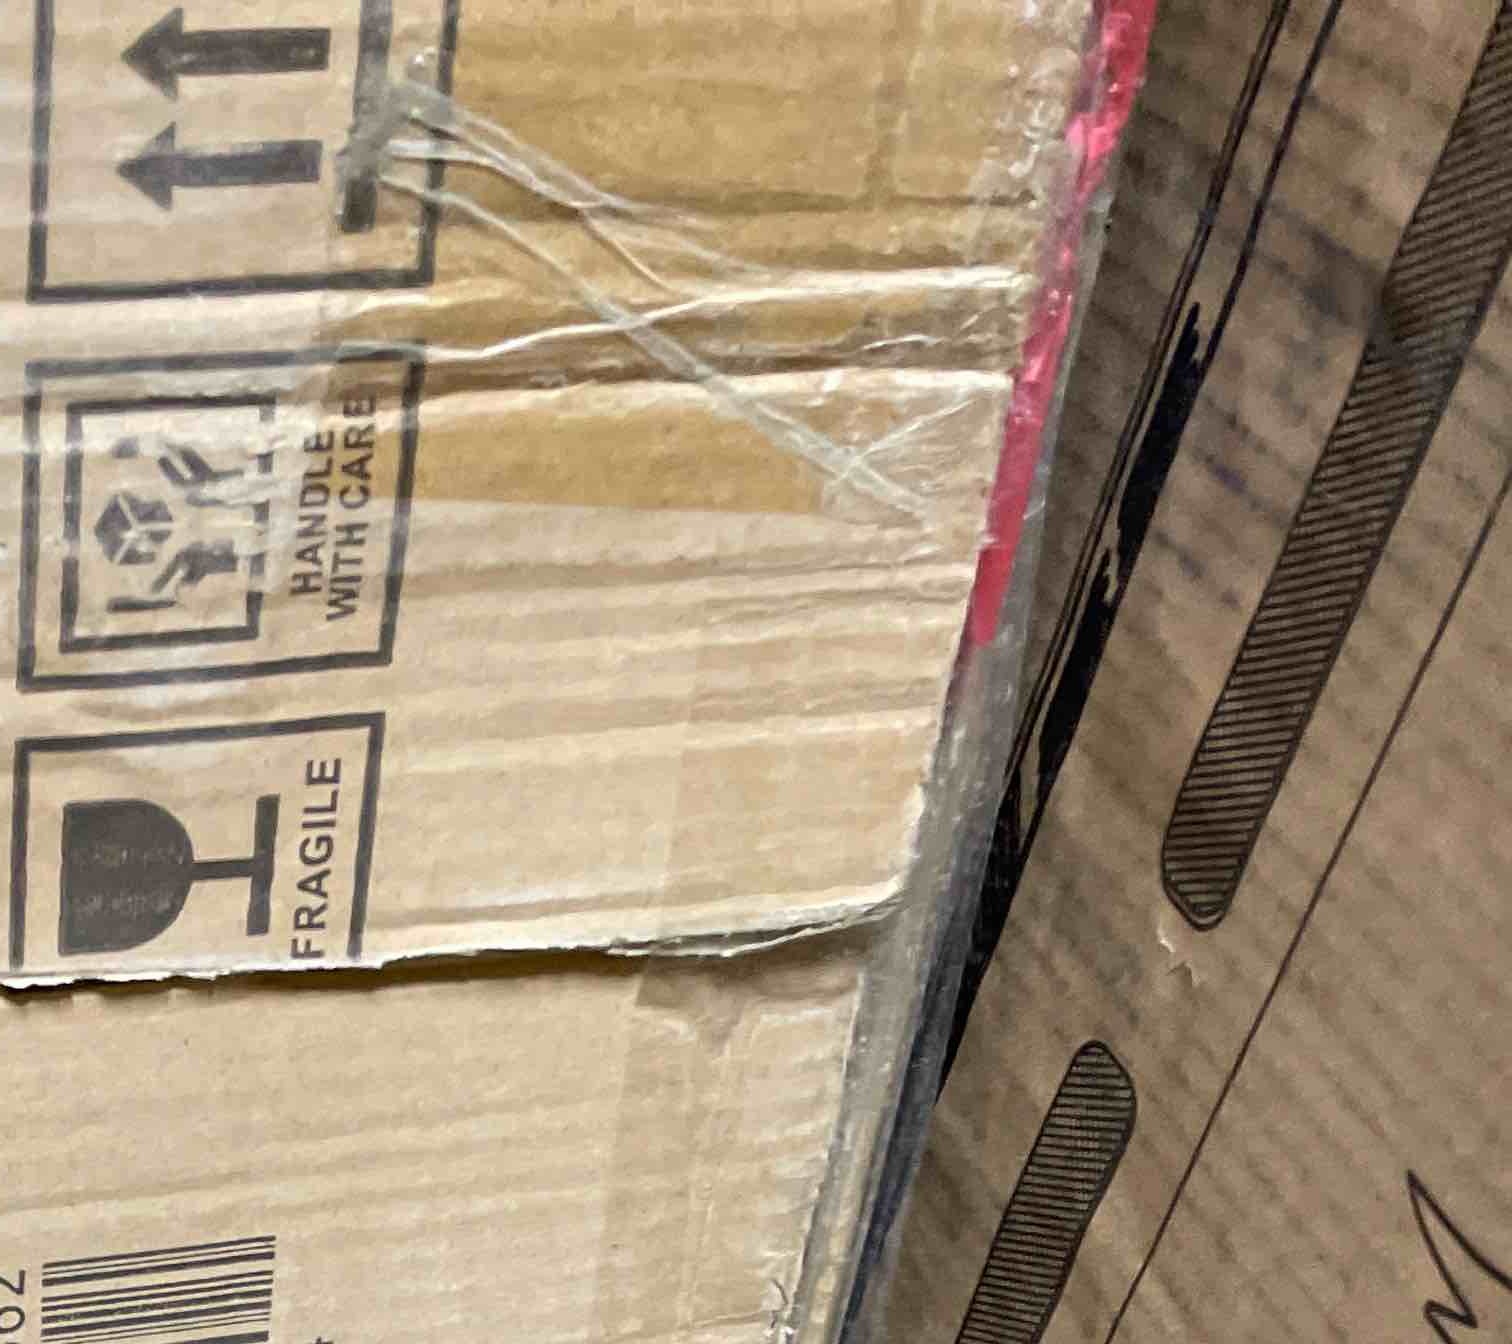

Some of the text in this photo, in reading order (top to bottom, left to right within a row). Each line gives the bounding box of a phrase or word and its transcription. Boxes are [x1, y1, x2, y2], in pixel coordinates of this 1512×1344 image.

[291, 429, 335, 596] HANDLE
[326, 396, 376, 623] WITH CARE
[291, 757, 342, 960] FRAGILE
